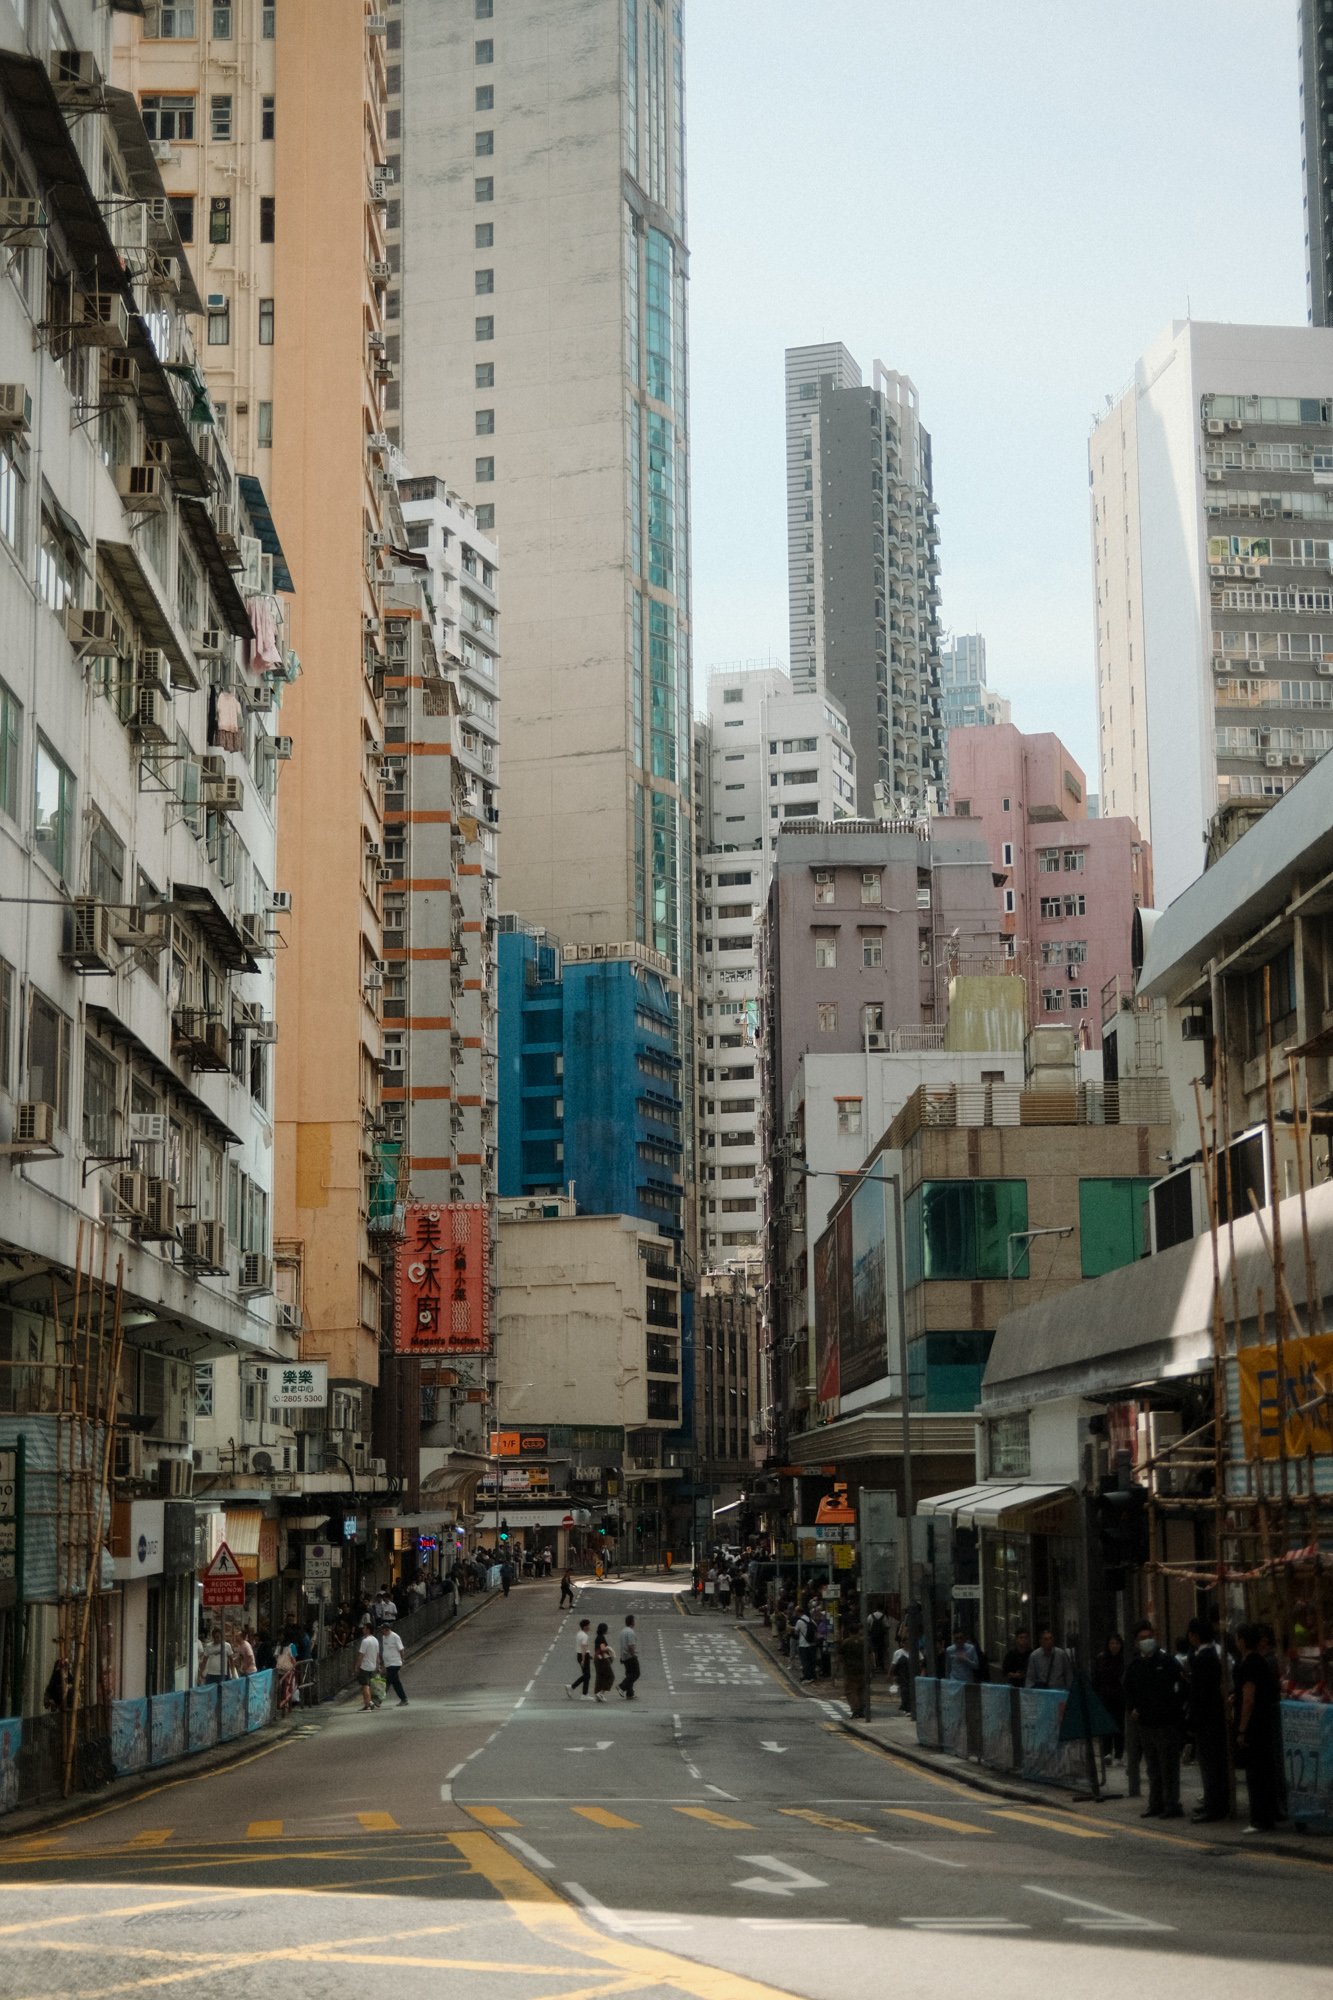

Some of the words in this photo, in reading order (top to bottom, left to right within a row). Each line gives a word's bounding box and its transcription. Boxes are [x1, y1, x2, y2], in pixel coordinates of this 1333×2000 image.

[411, 1336, 445, 1346] Megan's
[448, 1334, 480, 1345] Kitchen
[283, 1370, 313, 1384] 樂樂
